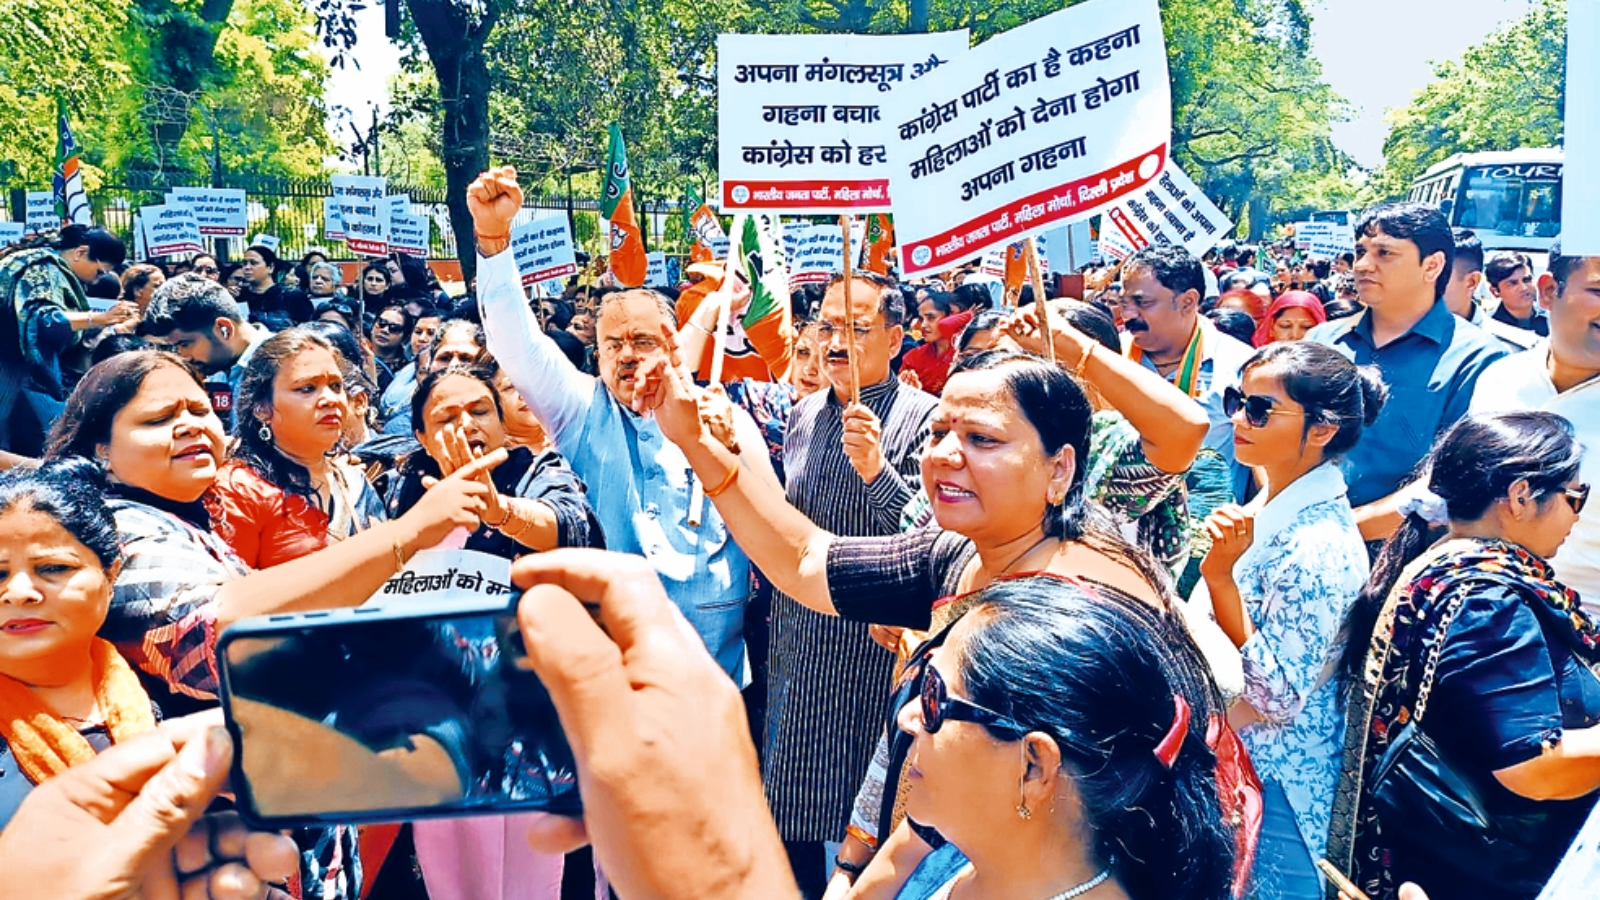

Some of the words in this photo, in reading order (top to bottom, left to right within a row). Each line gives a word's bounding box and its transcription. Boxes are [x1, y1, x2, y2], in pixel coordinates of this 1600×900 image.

[734, 64, 799, 83] अपना
[805, 56, 904, 92] मंगलसूत्र
[898, 99, 958, 142] कांग्रेस
[961, 69, 1000, 109] पार्टी
[1005, 62, 1037, 89] का
[1042, 47, 1062, 79] है
[1067, 24, 1141, 66] कहना
[762, 105, 827, 125] गहना
[909, 118, 993, 179] महिलाओं
[995, 106, 1026, 140] को
[1030, 93, 1077, 124] देना
[1082, 70, 1141, 110] होगा
[741, 139, 815, 168] कांग्रेस
[820, 138, 852, 164] को
[857, 145, 887, 166] हर
[961, 161, 1015, 202] अपना
[1019, 136, 1087, 173] गहना
[753, 187, 783, 201] भारतीय
[785, 189, 810, 200] जनता
[834, 187, 860, 200] महिला
[935, 235, 965, 257] भारतीय
[966, 224, 991, 244] जनता
[1013, 203, 1046, 224] महिला
[1078, 178, 1108, 203] दिल्ली
[1109, 170, 1135, 193] प्रदेश
[214, 394, 229, 407] 18
[383, 568, 458, 595] महिलाओं
[456, 570, 484, 592] को
